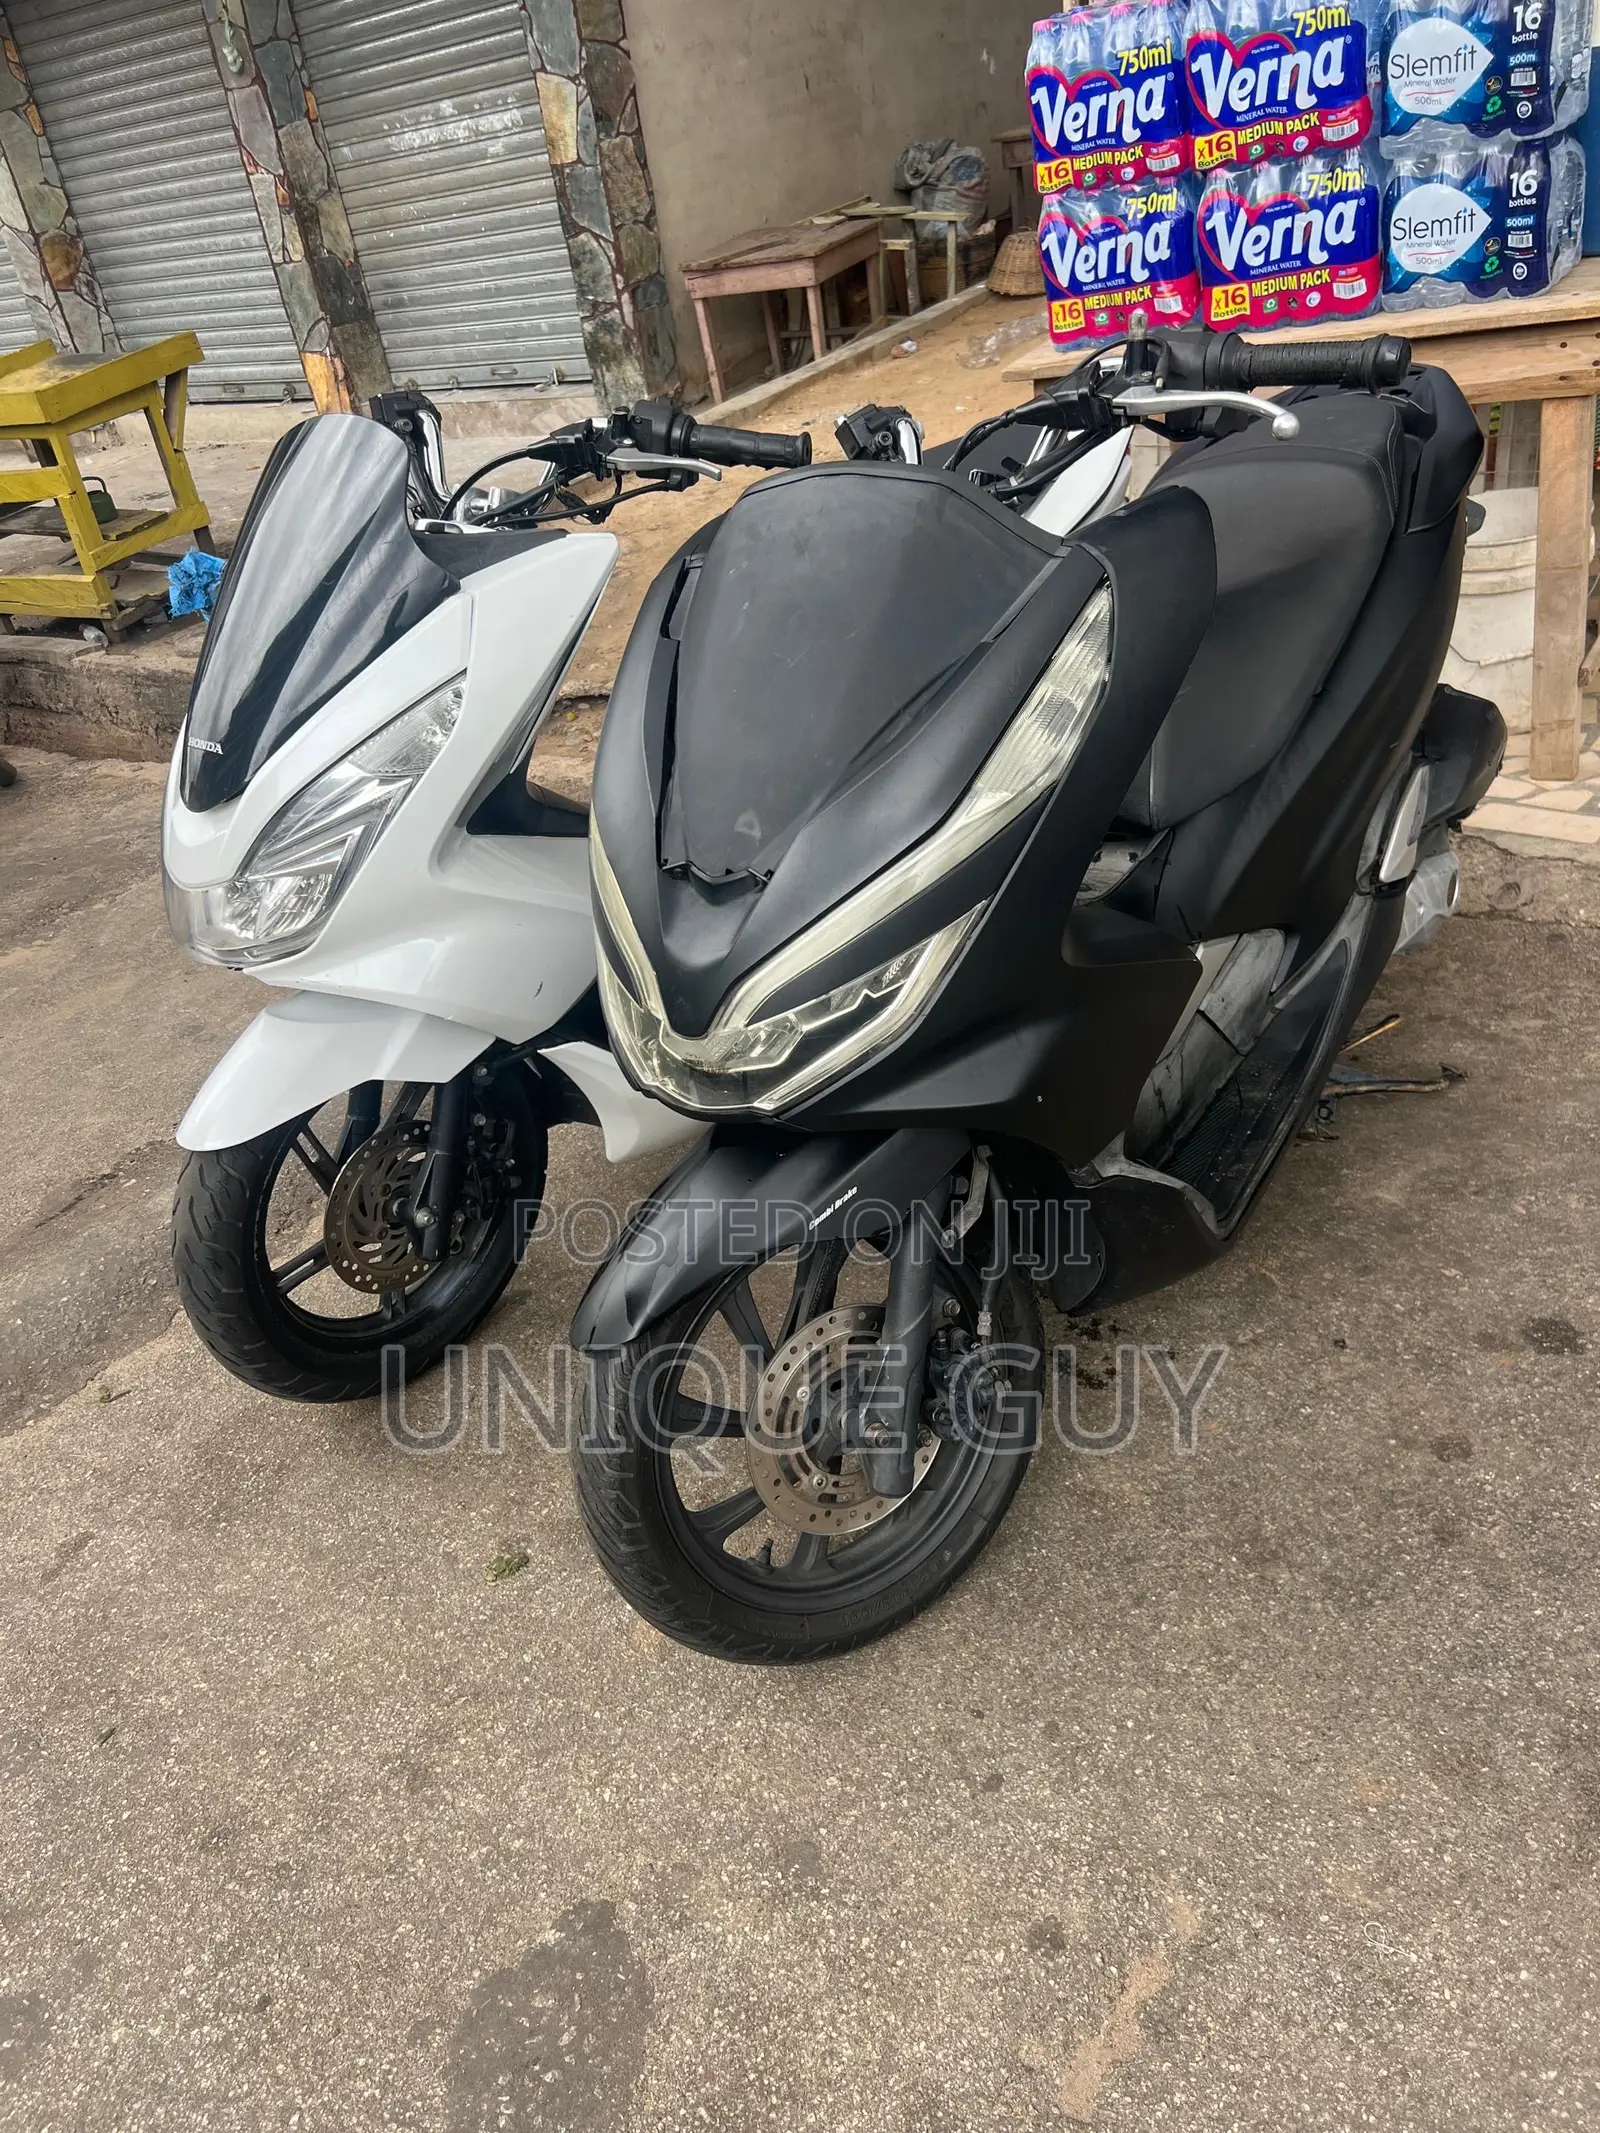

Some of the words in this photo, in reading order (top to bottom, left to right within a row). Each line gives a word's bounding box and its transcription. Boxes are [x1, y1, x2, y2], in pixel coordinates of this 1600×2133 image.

[1293, 5, 1350, 38] 750ml
[1513, 2, 1542, 32] 16
[1117, 38, 1172, 76] 750ml
[1390, 44, 1477, 80] Slemfit
[1191, 36, 1346, 119] Verna
[1404, 79, 1431, 88] Mineral
[1433, 76, 1456, 86] Water
[1031, 75, 1166, 148] Verna
[1236, 109, 1265, 123] MINERAL
[1265, 106, 1288, 116] WATER
[1237, 119, 1284, 145] MEDIUM
[1286, 111, 1320, 136] PACK
[1071, 139, 1096, 152] MINERAL
[1096, 137, 1116, 149] WATER
[1073, 151, 1113, 171] MEDIUM
[1114, 145, 1144, 166] PACK
[1198, 153, 1234, 168] Bottles
[1039, 179, 1072, 193] Bottles
[1308, 164, 1365, 198] 750ml
[1510, 169, 1538, 198] 16
[1127, 188, 1177, 220] 750ml
[1508, 197, 1537, 208] bottles
[1393, 206, 1476, 241] Slemfit
[1506, 215, 1533, 227] 500ml
[1205, 199, 1358, 271] Verna
[1406, 240, 1432, 249] Mineral
[1434, 238, 1457, 247] Water
[1041, 220, 1171, 288] Verna
[1250, 263, 1279, 276] MINERAL
[1279, 260, 1302, 270] WATER
[1106, 278, 1126, 288] WATER
[1252, 274, 1298, 298] MEDIUM
[1300, 268, 1331, 291] PACK
[1084, 292, 1123, 310] MEDIUM
[1124, 285, 1152, 306] PACK
[1054, 320, 1083, 331] Bottles
[1213, 307, 1248, 319] Bottles
[188, 737, 223, 755] HONDA
[809, 1203, 834, 1231] Combi
[834, 1186, 858, 1210] Brake
